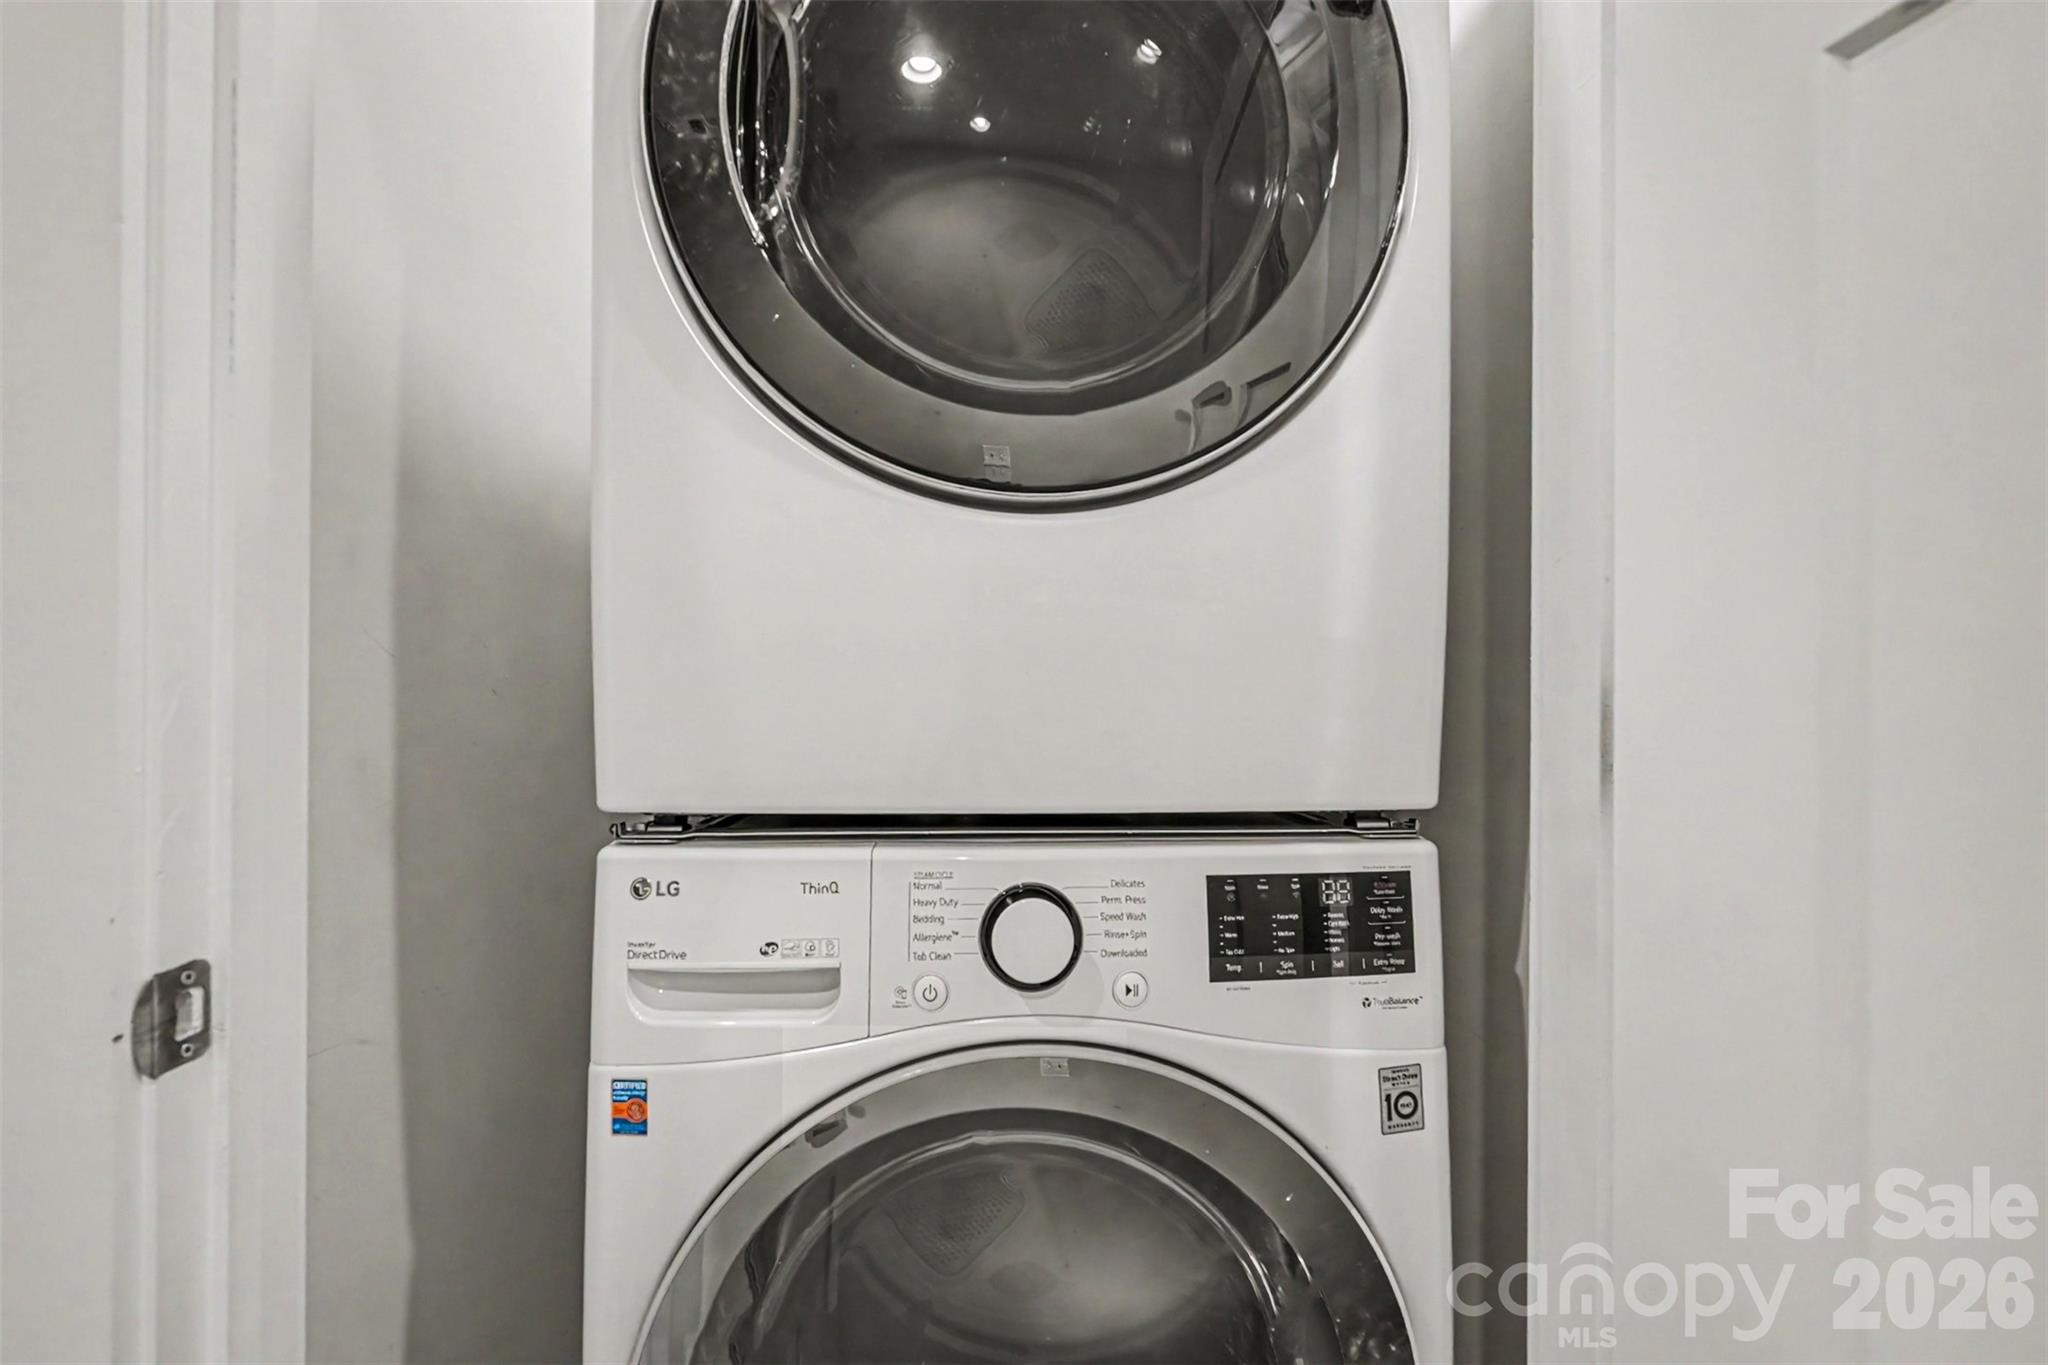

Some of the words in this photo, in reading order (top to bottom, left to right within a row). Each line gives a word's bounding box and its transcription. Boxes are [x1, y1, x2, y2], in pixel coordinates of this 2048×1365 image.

[655, 881, 680, 897] LG
[800, 881, 840, 895] ThinQ
[913, 881, 942, 890] Normal
[1110, 880, 1146, 888] Delicates
[913, 898, 937, 909] Heavy
[939, 897, 959, 908] Duty
[1125, 895, 1146, 904] Press
[913, 914, 945, 926] Bedding
[1100, 912, 1124, 922] Speed
[1126, 912, 1146, 920] Wash
[929, 951, 952, 961] Clean
[1100, 948, 1148, 958] Downloaded
[1384, 1090, 1418, 1122] 10
